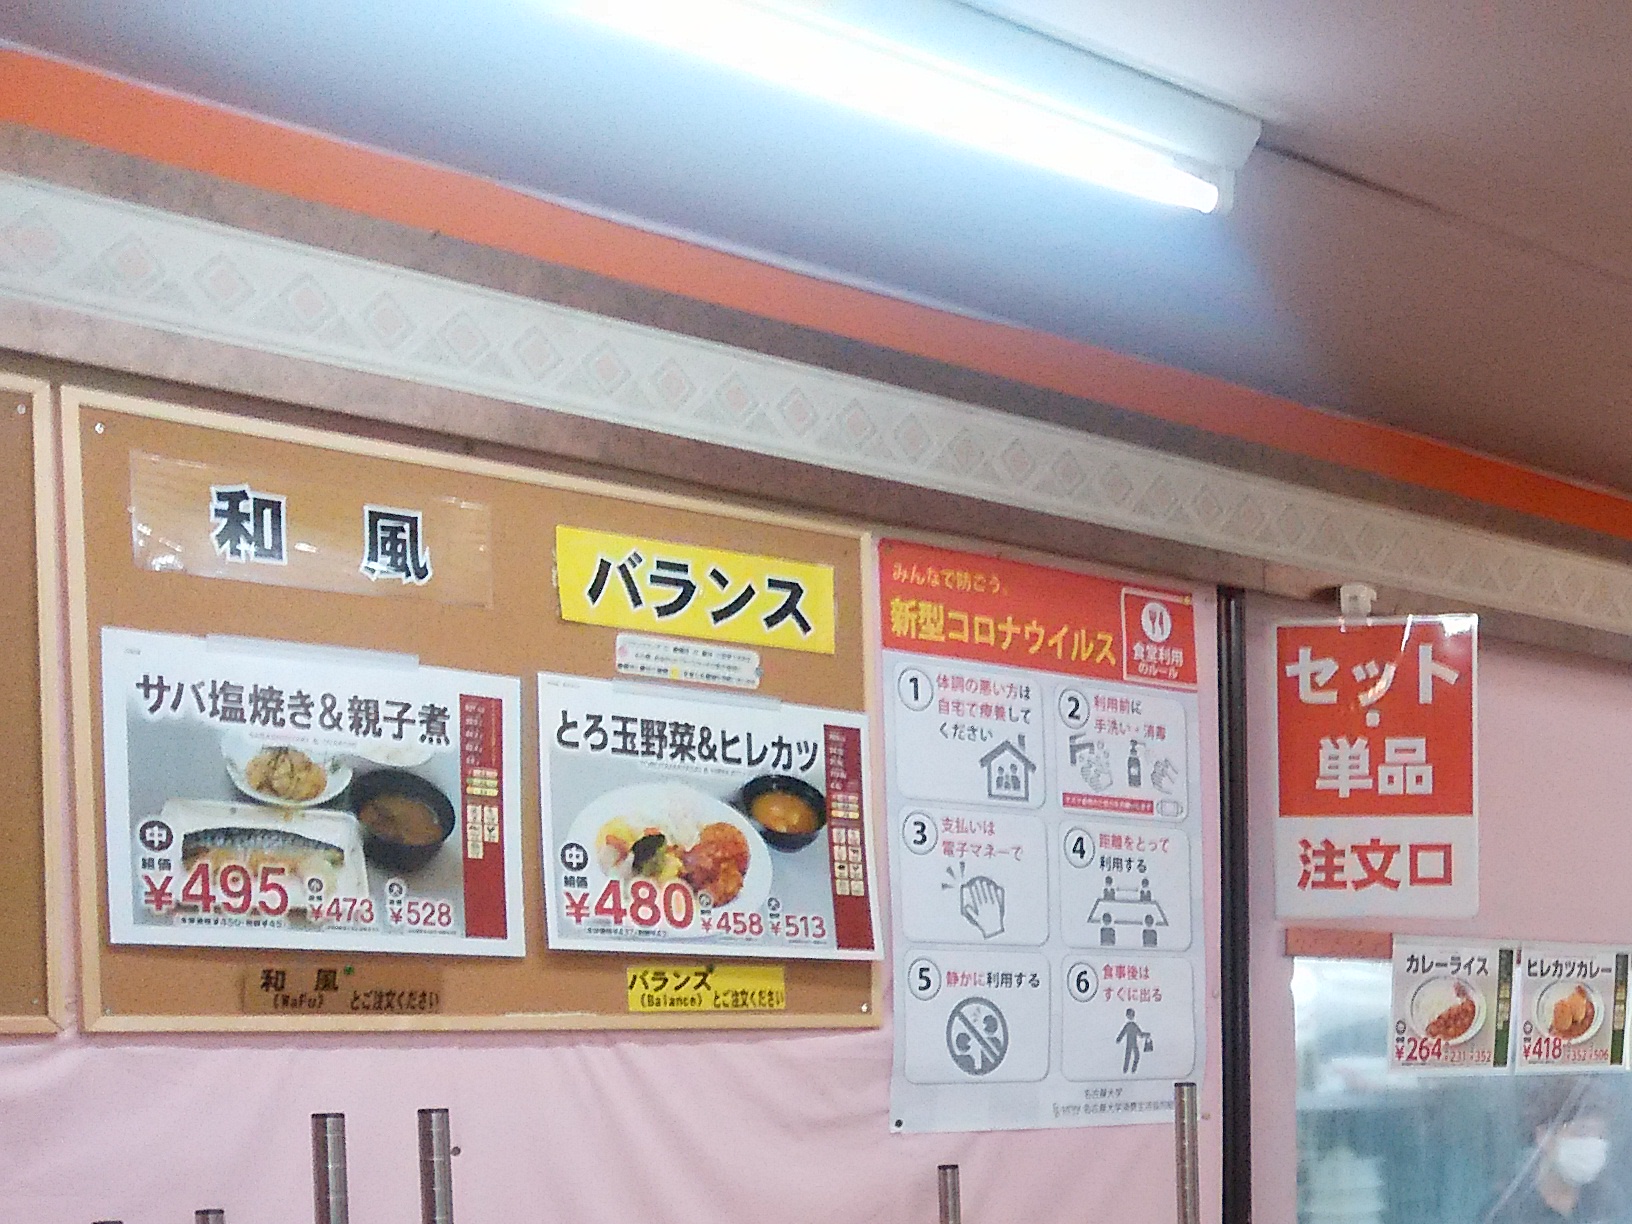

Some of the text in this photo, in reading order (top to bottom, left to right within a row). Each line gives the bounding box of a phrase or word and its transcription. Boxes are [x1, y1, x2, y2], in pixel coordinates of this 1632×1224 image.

[587, 553, 813, 636] バランス
[890, 597, 1117, 667] 新型コロナウイルス
[1132, 641, 1183, 668] 食堂利用
[1138, 661, 1179, 679] のルール
[1285, 643, 1461, 708] セット
[936, 673, 1032, 701] 体調の悪い方は
[136, 673, 451, 746] サバ塩焼き&親子煮
[937, 698, 1032, 723] 自宅で療養して
[1094, 694, 1142, 717] 利用前に
[556, 709, 819, 772] とろ玉野菜&ヒレカツ
[939, 721, 994, 742] ください
[1315, 736, 1434, 799] 単品
[941, 816, 996, 837] 支払いは
[942, 840, 1023, 862] 電子マネーで
[1099, 832, 1170, 854] 距離をとって
[1099, 856, 1147, 874] 利用する
[1296, 838, 1454, 892] 注文口
[143, 863, 289, 916] ¥495
[310, 897, 375, 924] ¥473
[390, 901, 452, 928] ¥528
[564, 879, 694, 929] ¥480
[701, 912, 764, 936] ¥458
[771, 915, 826, 939] ¥513
[1102, 963, 1150, 982] 食事後は
[1406, 954, 1489, 976] カレーライス
[1527, 958, 1612, 980] ヒレカツカレー
[628, 970, 711, 993] バランス
[946, 969, 1040, 990] 静かに利用する
[350, 990, 439, 1011] とご注文ください
[714, 989, 784, 1010] とご注文ください
[1103, 983, 1163, 1003] すぐに出る
[1395, 1037, 1442, 1062] ¥264
[1523, 1037, 1562, 1061] ¥418
